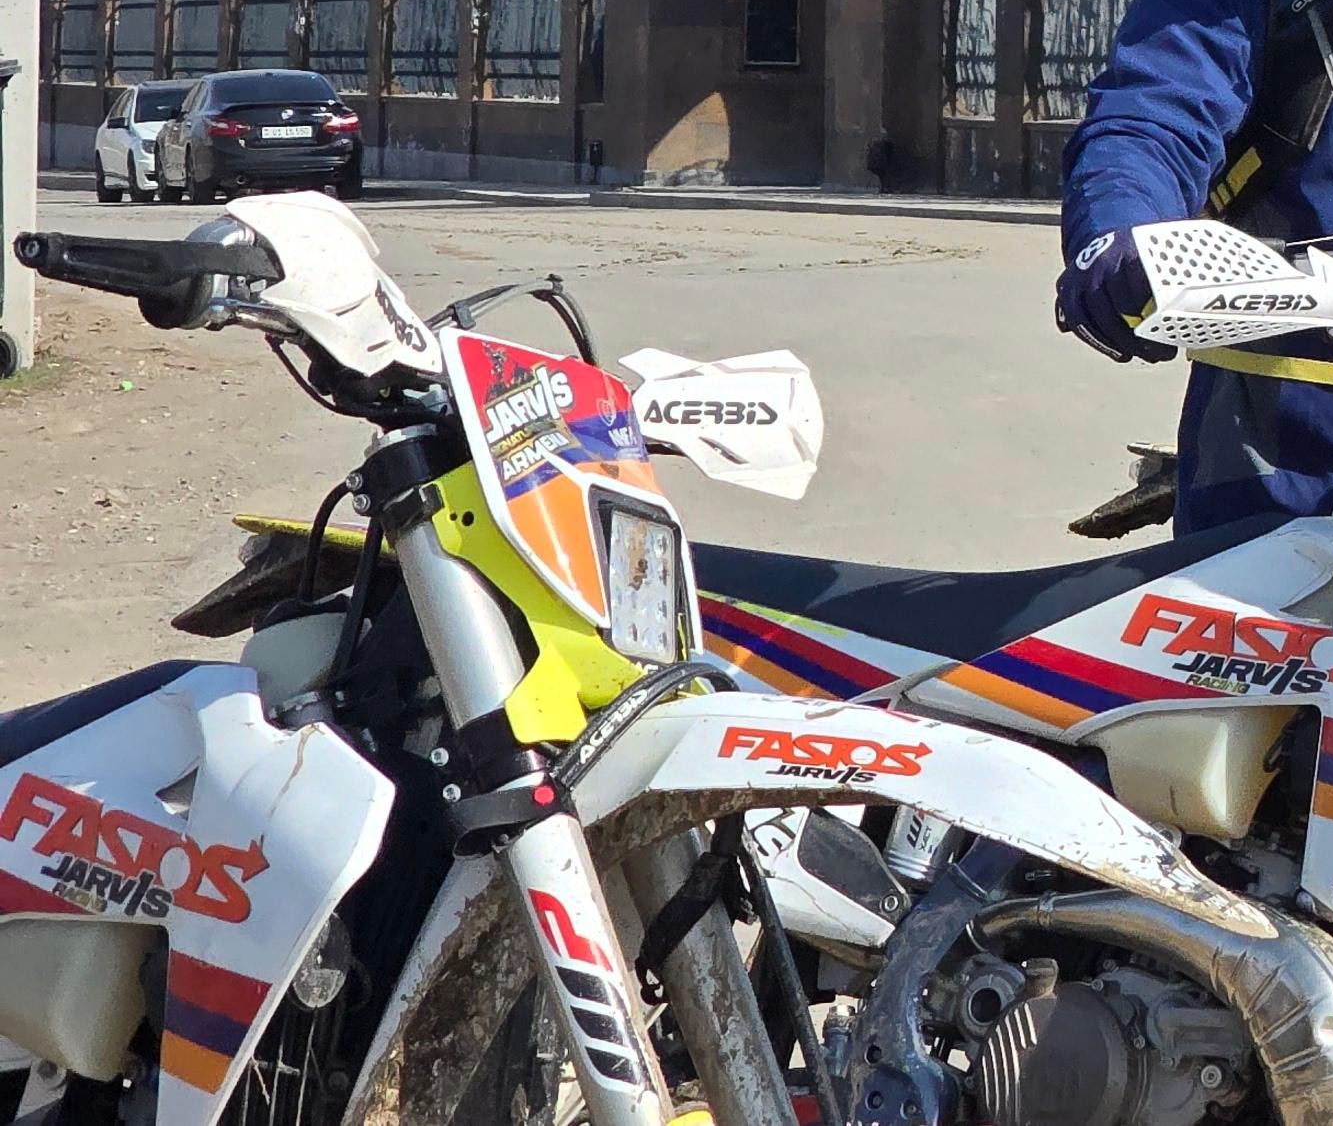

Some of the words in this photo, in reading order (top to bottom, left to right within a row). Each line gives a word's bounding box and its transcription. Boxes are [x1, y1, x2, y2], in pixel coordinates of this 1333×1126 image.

[1203, 293, 1318, 313] ACERBIS
[486, 365, 574, 444] JARVIS
[643, 399, 779, 425] ACERBIS
[1172, 651, 1328, 695] JARVIS
[766, 765, 878, 785] JARVIS
[41, 855, 175, 919] JARVIS
